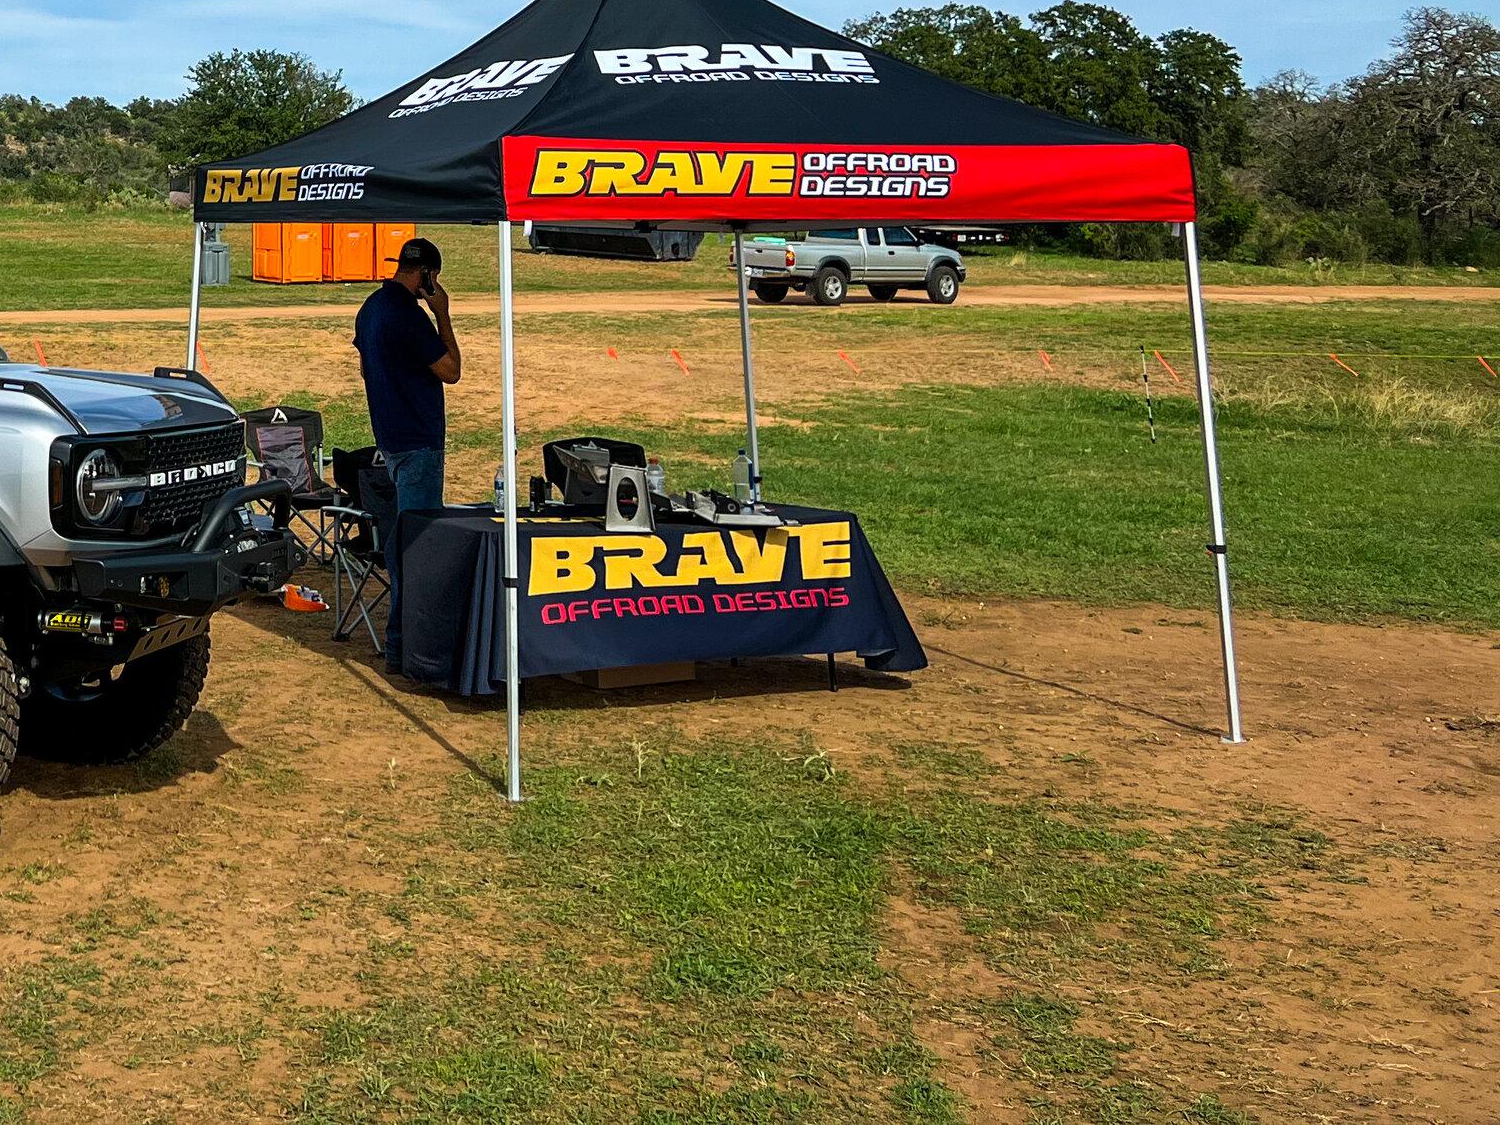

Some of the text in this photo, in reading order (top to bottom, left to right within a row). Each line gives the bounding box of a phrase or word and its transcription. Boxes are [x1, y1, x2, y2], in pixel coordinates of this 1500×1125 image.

[593, 43, 876, 74] BRAVE
[398, 52, 576, 107] BRAVE
[614, 70, 881, 85] OFFROAD DESIGNS
[452, 86, 529, 103] DESIGNS
[301, 163, 375, 180] OFFROAD
[530, 149, 797, 196] BRAVE
[803, 153, 956, 173] OFFROAD
[203, 166, 302, 204] BRAVE
[297, 182, 365, 202] DESIGNS
[800, 175, 950, 197] DESIGNS
[150, 460, 237, 487] BRONCO
[528, 521, 851, 596] BRAVE
[541, 587, 850, 625] OFFROAD DESIGNS
